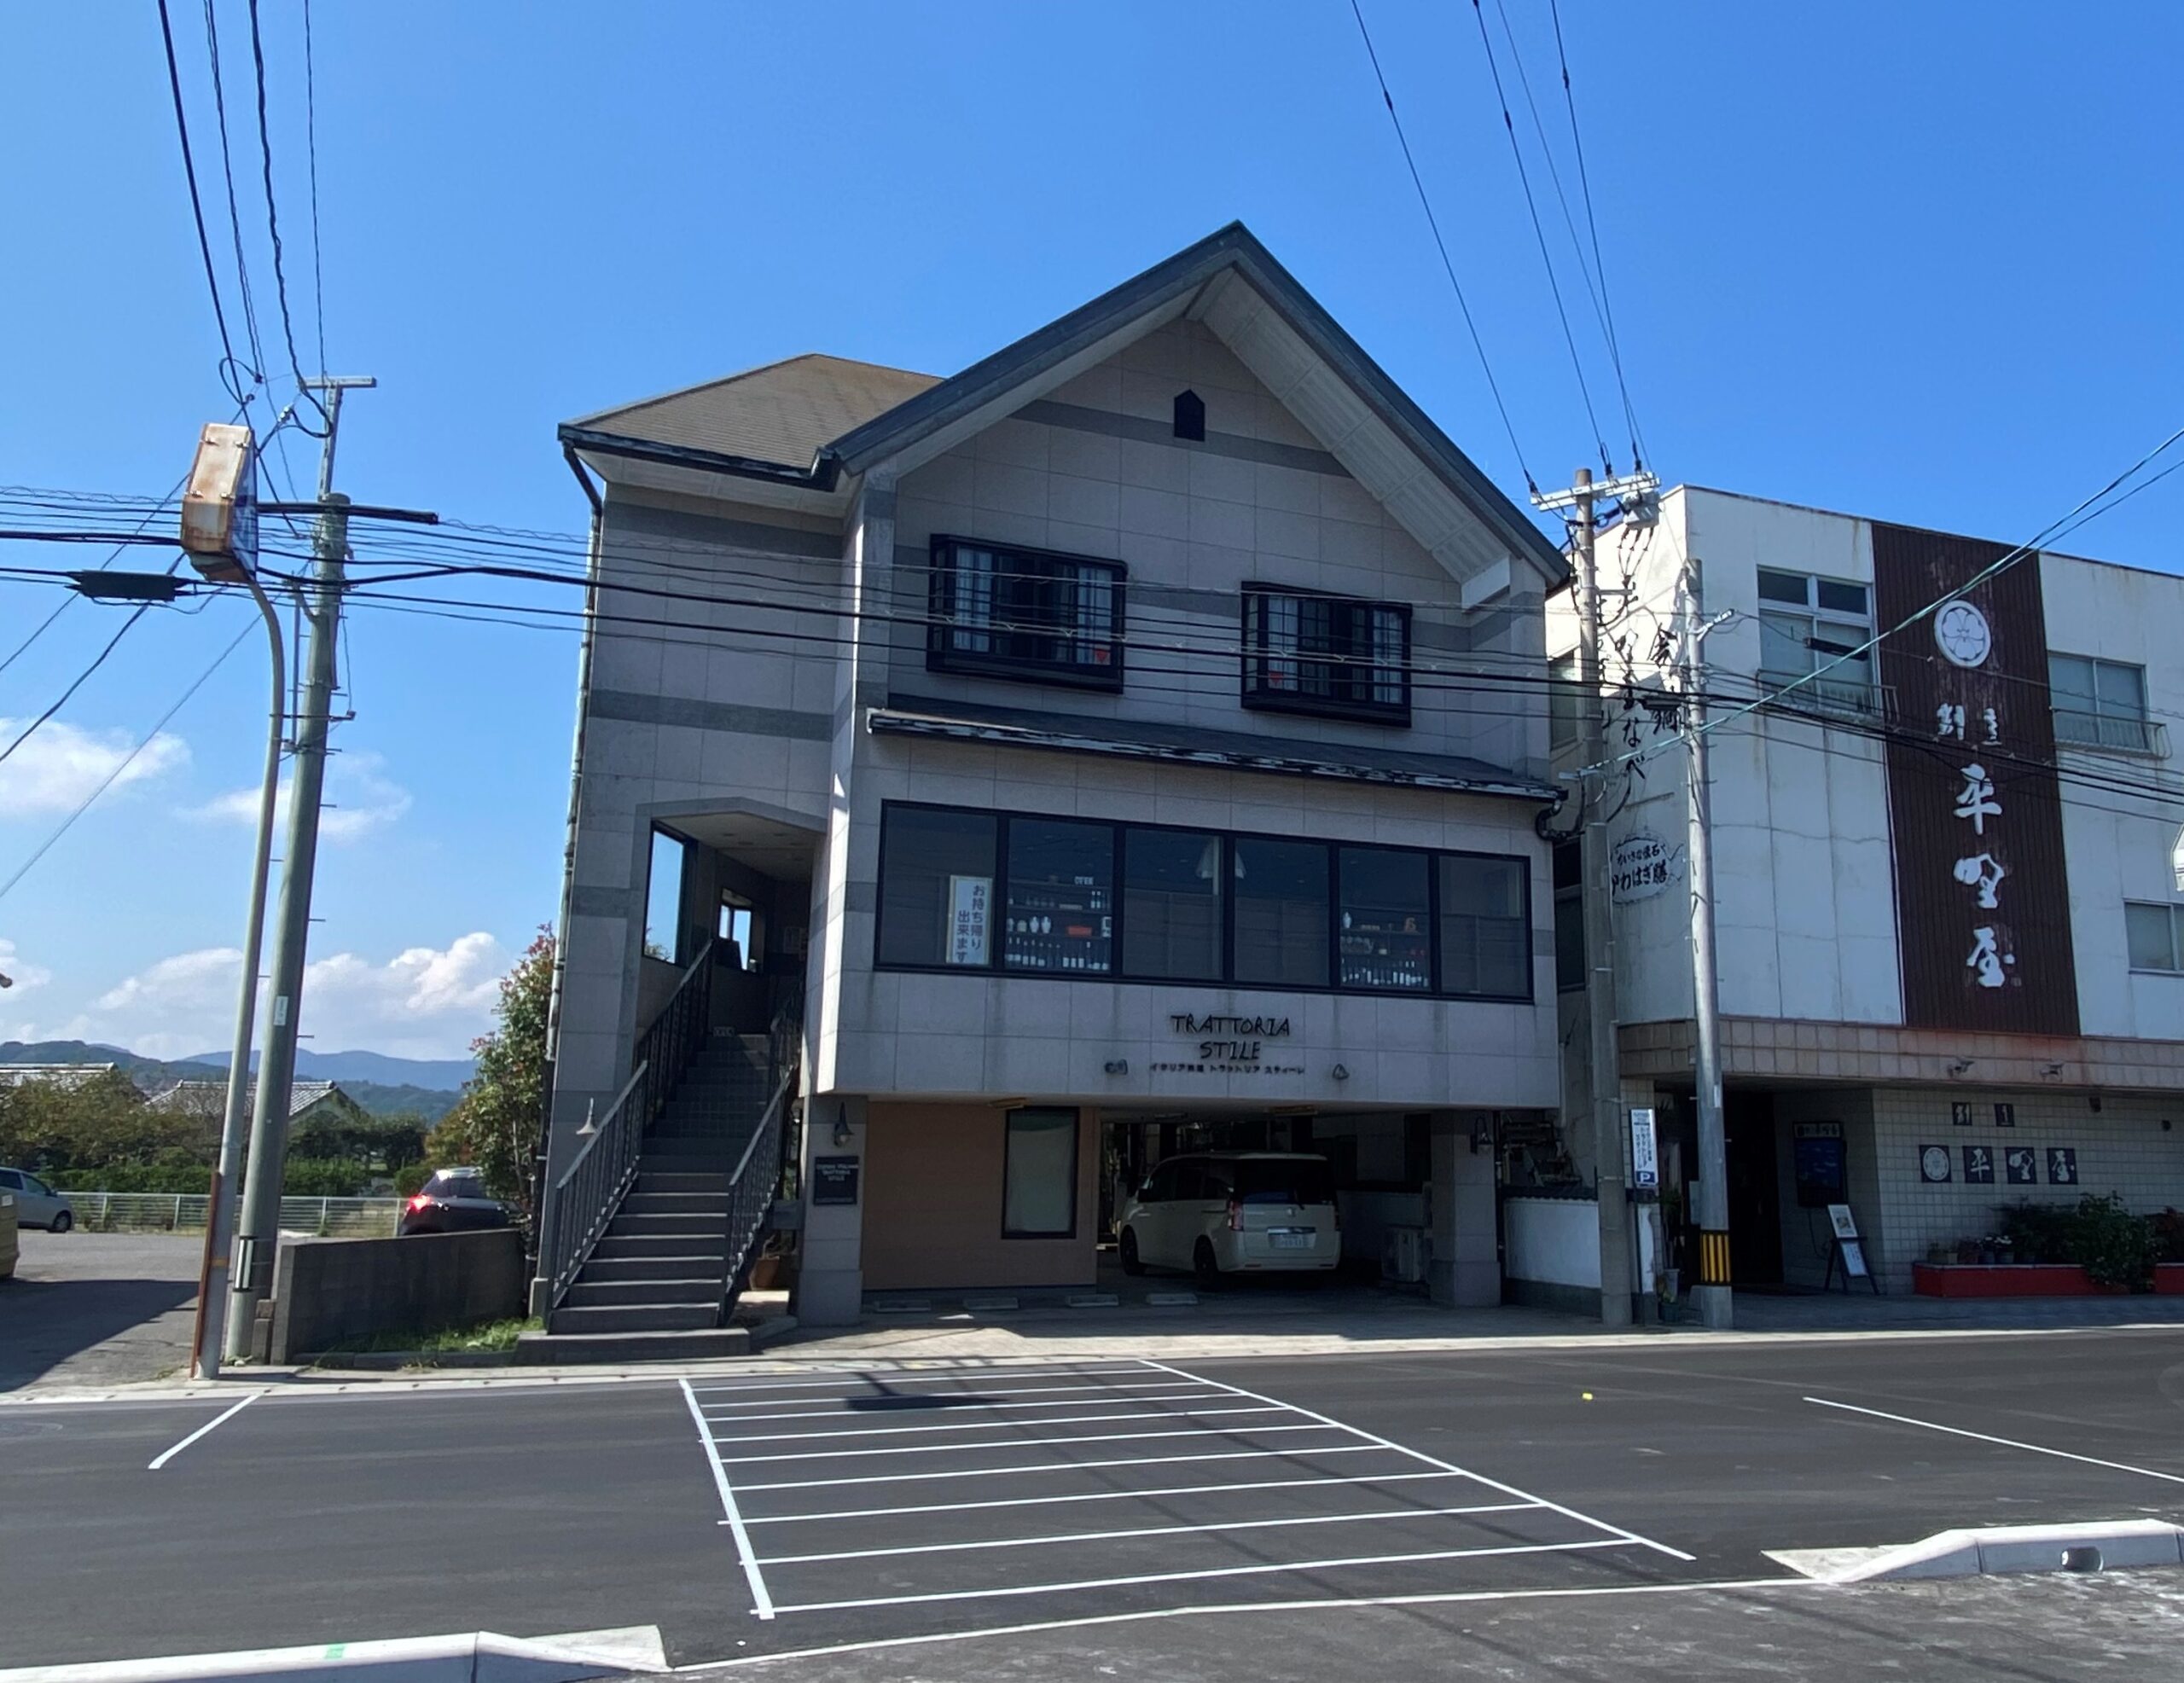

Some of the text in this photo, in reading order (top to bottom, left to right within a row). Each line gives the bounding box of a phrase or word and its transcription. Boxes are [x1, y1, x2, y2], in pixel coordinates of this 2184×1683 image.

[1953, 762, 2015, 988] 平野屋
[970, 884, 986, 951] お持ち帰り
[956, 910, 971, 964] 出来ます
[1170, 1013, 1291, 1036] TRATTORIA
[1199, 1041, 1262, 1060] STILE
[1640, 1172, 1651, 1182] P
[1970, 1147, 2075, 1182] 平野屋
